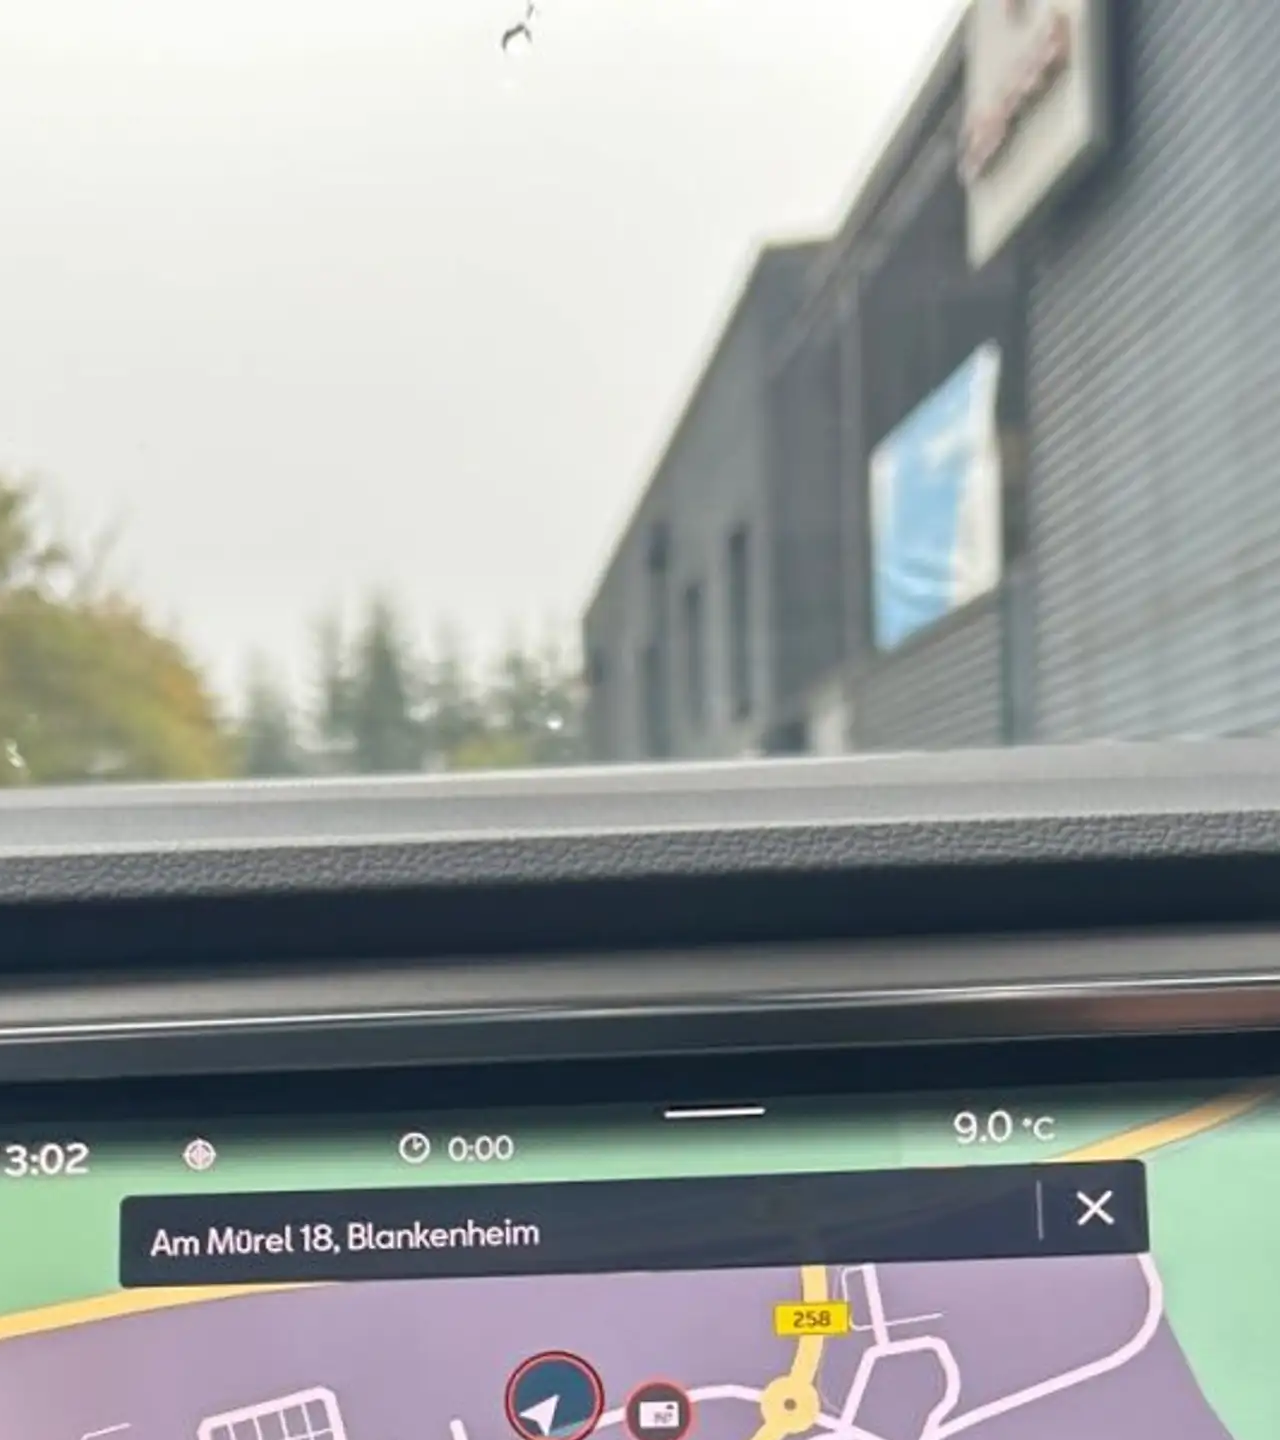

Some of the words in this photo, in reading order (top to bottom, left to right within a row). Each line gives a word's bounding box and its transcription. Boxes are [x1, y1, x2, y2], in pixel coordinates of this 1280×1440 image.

[953, 1110, 1013, 1144] 9.0
[448, 1135, 514, 1163] 0:00
[150, 1228, 200, 1258] Am
[207, 1224, 294, 1256] Mürel
[301, 1224, 341, 1258] 18,
[348, 1218, 540, 1252] Blankenheim
[792, 1309, 832, 1329] 258
